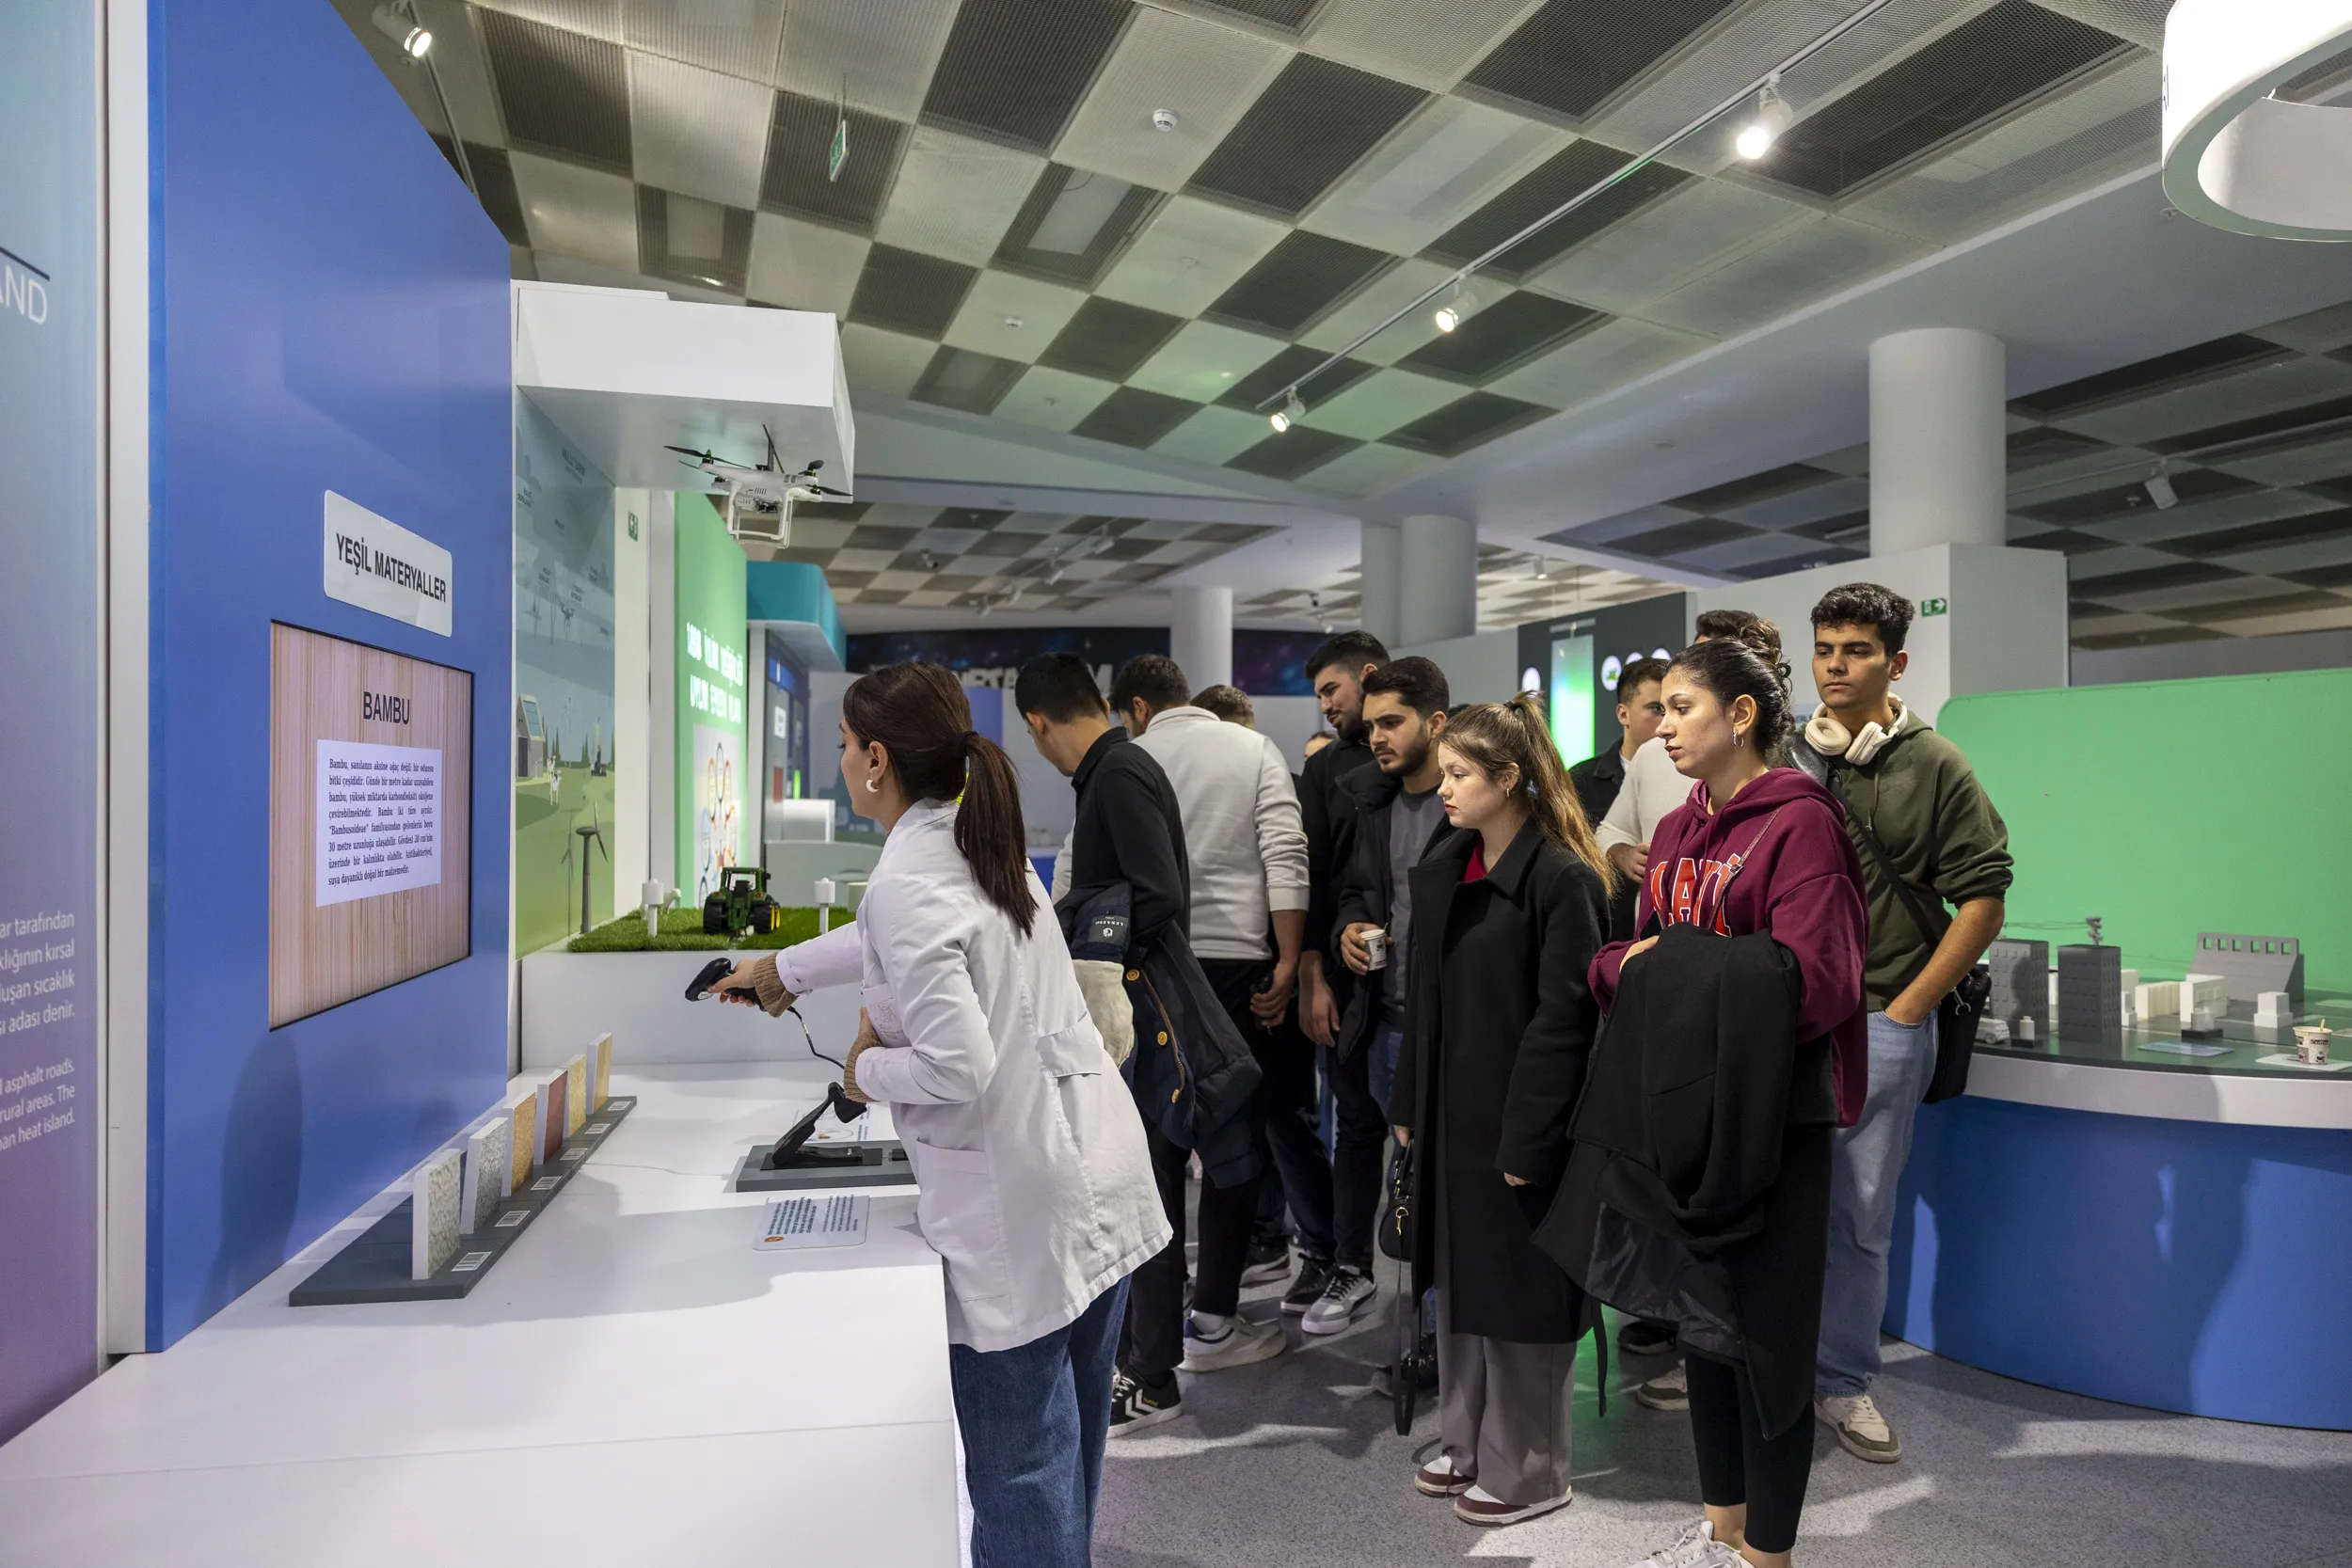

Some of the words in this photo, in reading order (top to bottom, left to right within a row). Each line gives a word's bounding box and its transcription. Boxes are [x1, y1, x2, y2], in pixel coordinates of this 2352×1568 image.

[0, 264, 48, 325] ND
[336, 532, 373, 576] YEŞİL
[374, 549, 447, 603] MATERYALLER
[363, 691, 410, 725] BAMBU
[329, 758, 349, 770] Bambu,
[329, 775, 342, 785] bitki
[329, 792, 347, 802] bambu,
[349, 792, 366, 804] yüksek
[328, 807, 373, 820] çevirebilmektedir.
[378, 807, 393, 816] Bambu
[328, 842, 336, 852] 30
[337, 842, 352, 851] metre
[328, 857, 350, 868] üzerinde
[328, 877, 342, 887] suya
[364, 869, 378, 881] doğal
[14, 910, 75, 936] tarafından
[45, 938, 75, 961] kırsal
[0, 982, 32, 1006] uşan
[34, 968, 75, 996] sıcaklık
[8, 1009, 40, 1033] adası
[42, 1000, 75, 1024] denir.
[5, 1066, 44, 1095] asphalt
[45, 1057, 75, 1081] roads.
[25, 1093, 56, 1114] areas.
[56, 1084, 75, 1102] The
[18, 1121, 42, 1144] heat
[43, 1106, 75, 1134] island.
